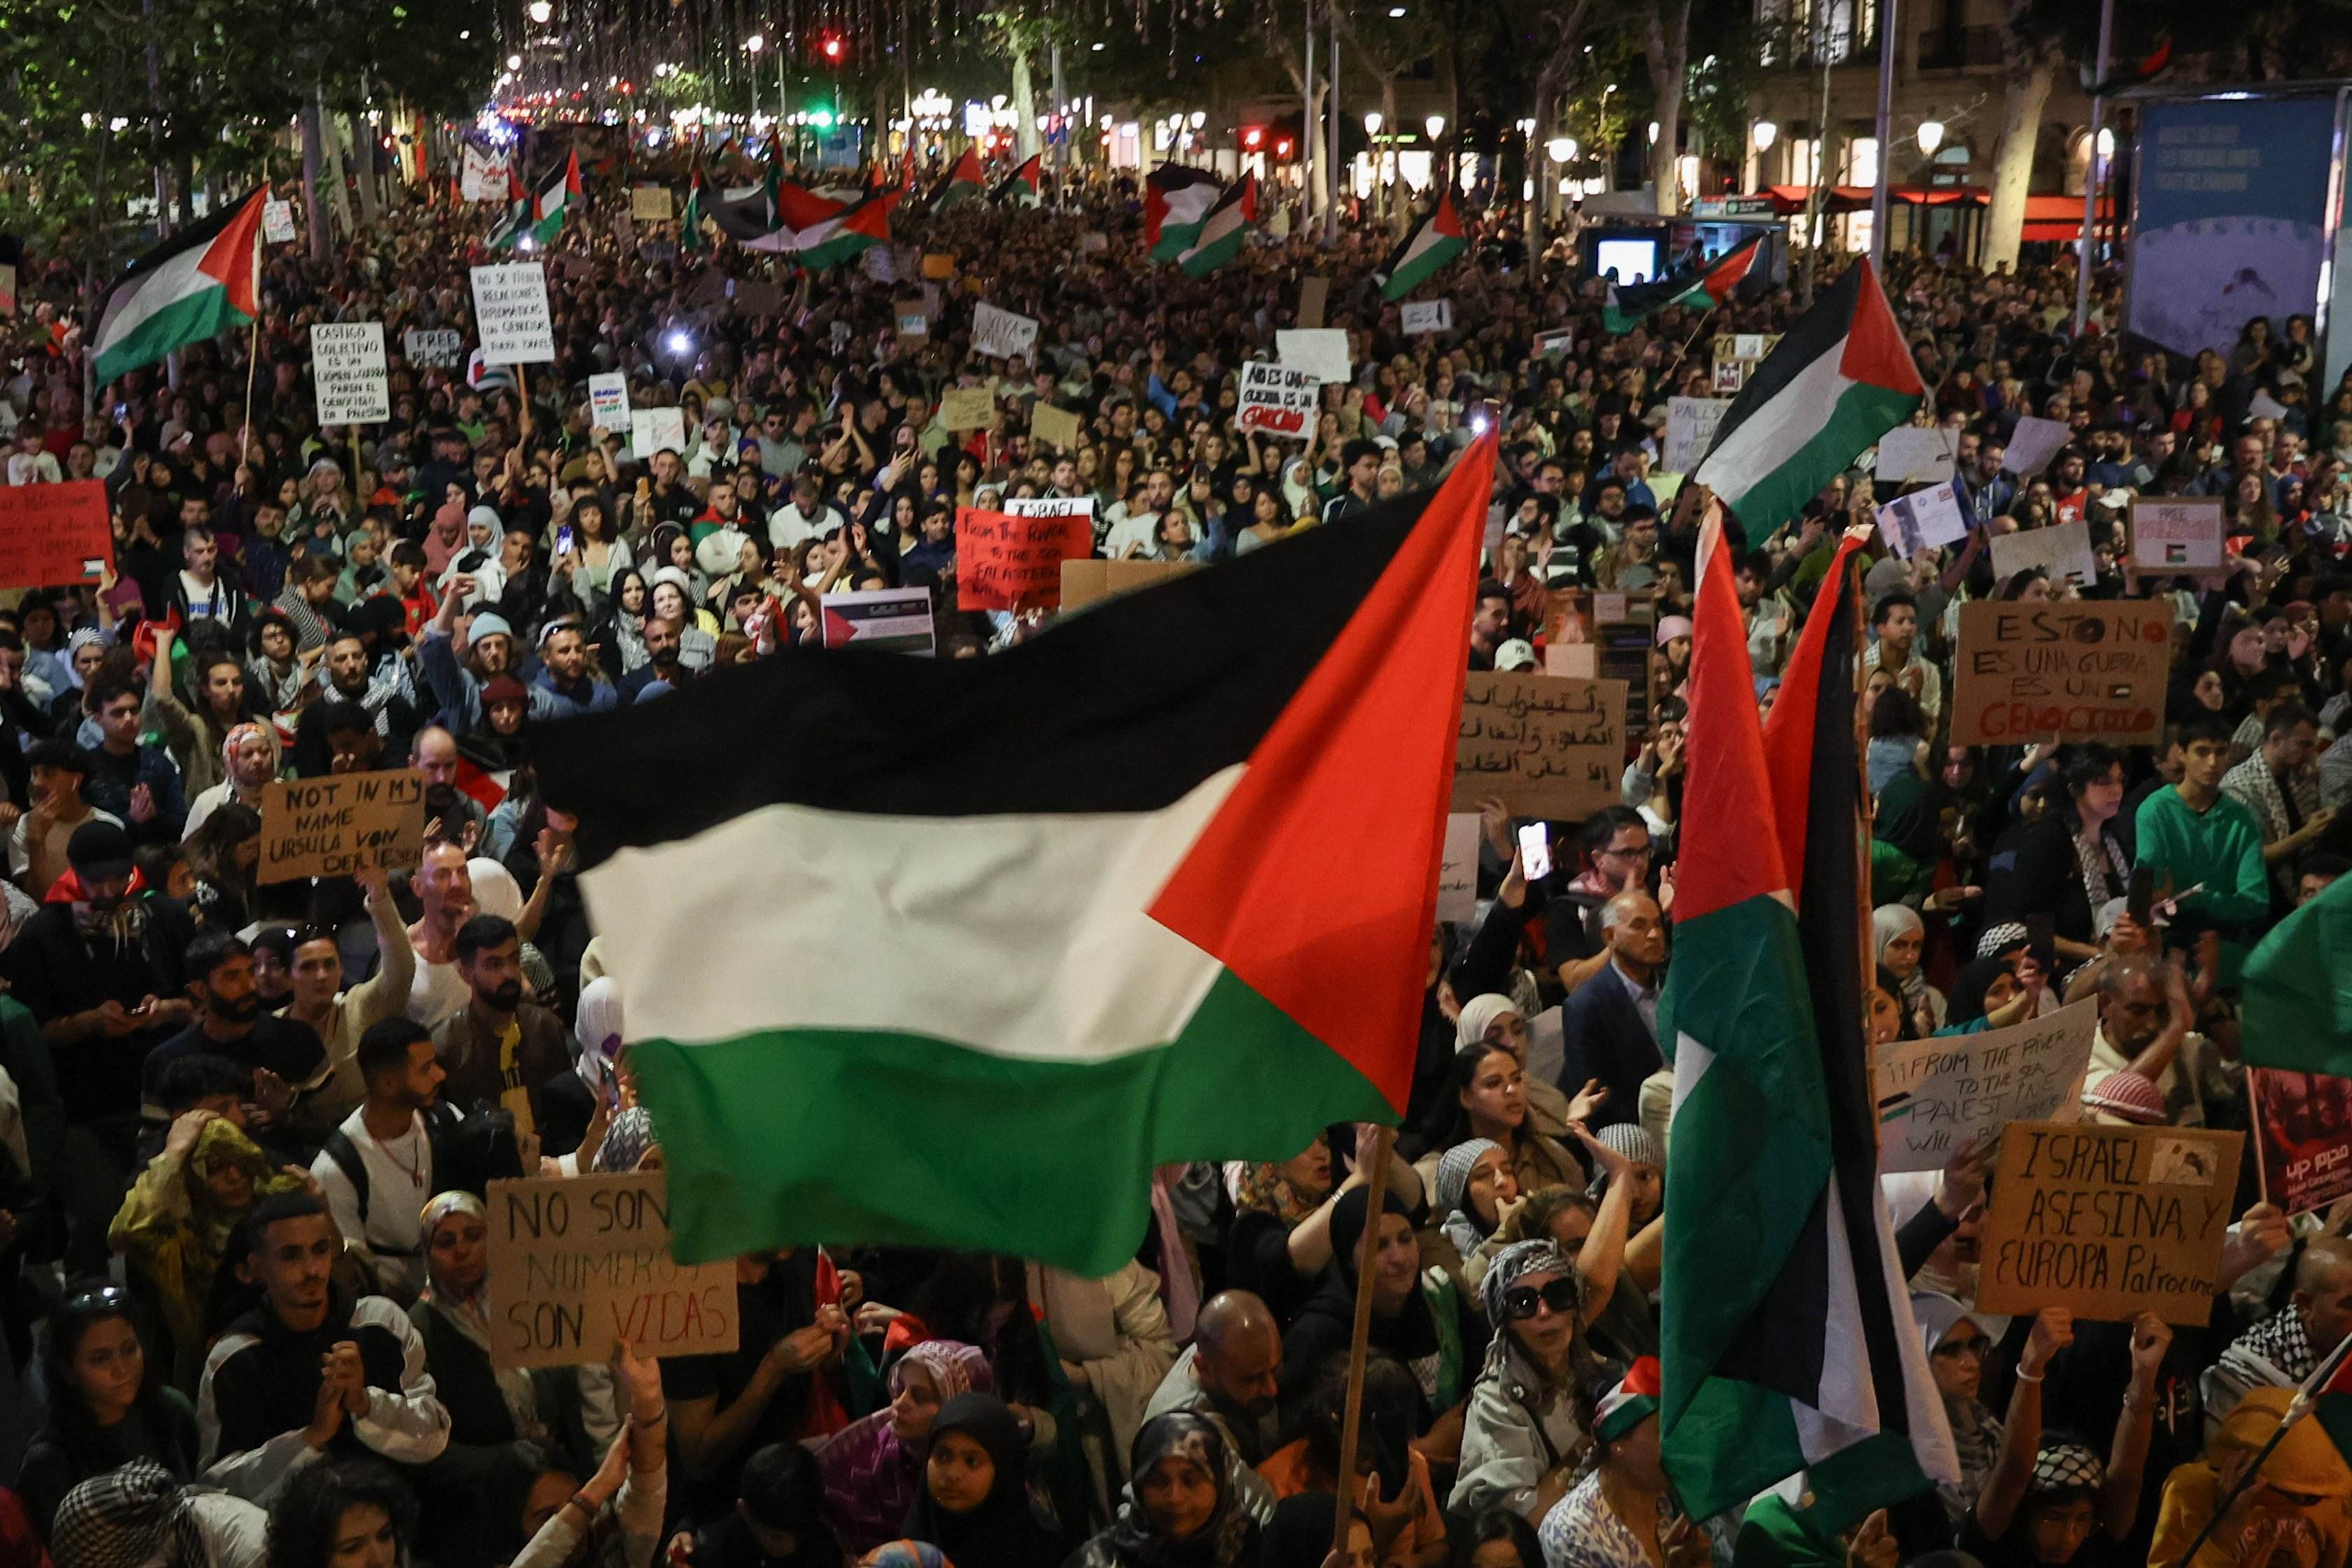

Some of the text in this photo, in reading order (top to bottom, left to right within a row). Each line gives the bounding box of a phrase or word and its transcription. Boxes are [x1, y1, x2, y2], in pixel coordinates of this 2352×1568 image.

[317, 325, 366, 340] CASTIGO
[1996, 611, 2167, 645] ESTO NO
[1973, 648, 2014, 676] ES
[2025, 648, 2070, 674] UNA
[2010, 676, 2100, 697] ES UN
[285, 777, 422, 811] NOT IN MY
[296, 806, 354, 832] NAME
[270, 833, 340, 864] URSULA
[323, 852, 369, 873] DER
[1956, 1078, 1979, 1095] TO
[2019, 1131, 2141, 1186] ISRAEL
[507, 1188, 672, 1241] NO SON
[2198, 1195, 2225, 1241] Y
[1996, 1240, 2109, 1290] EUROPA
[507, 1285, 727, 1353] SON VIDAS
